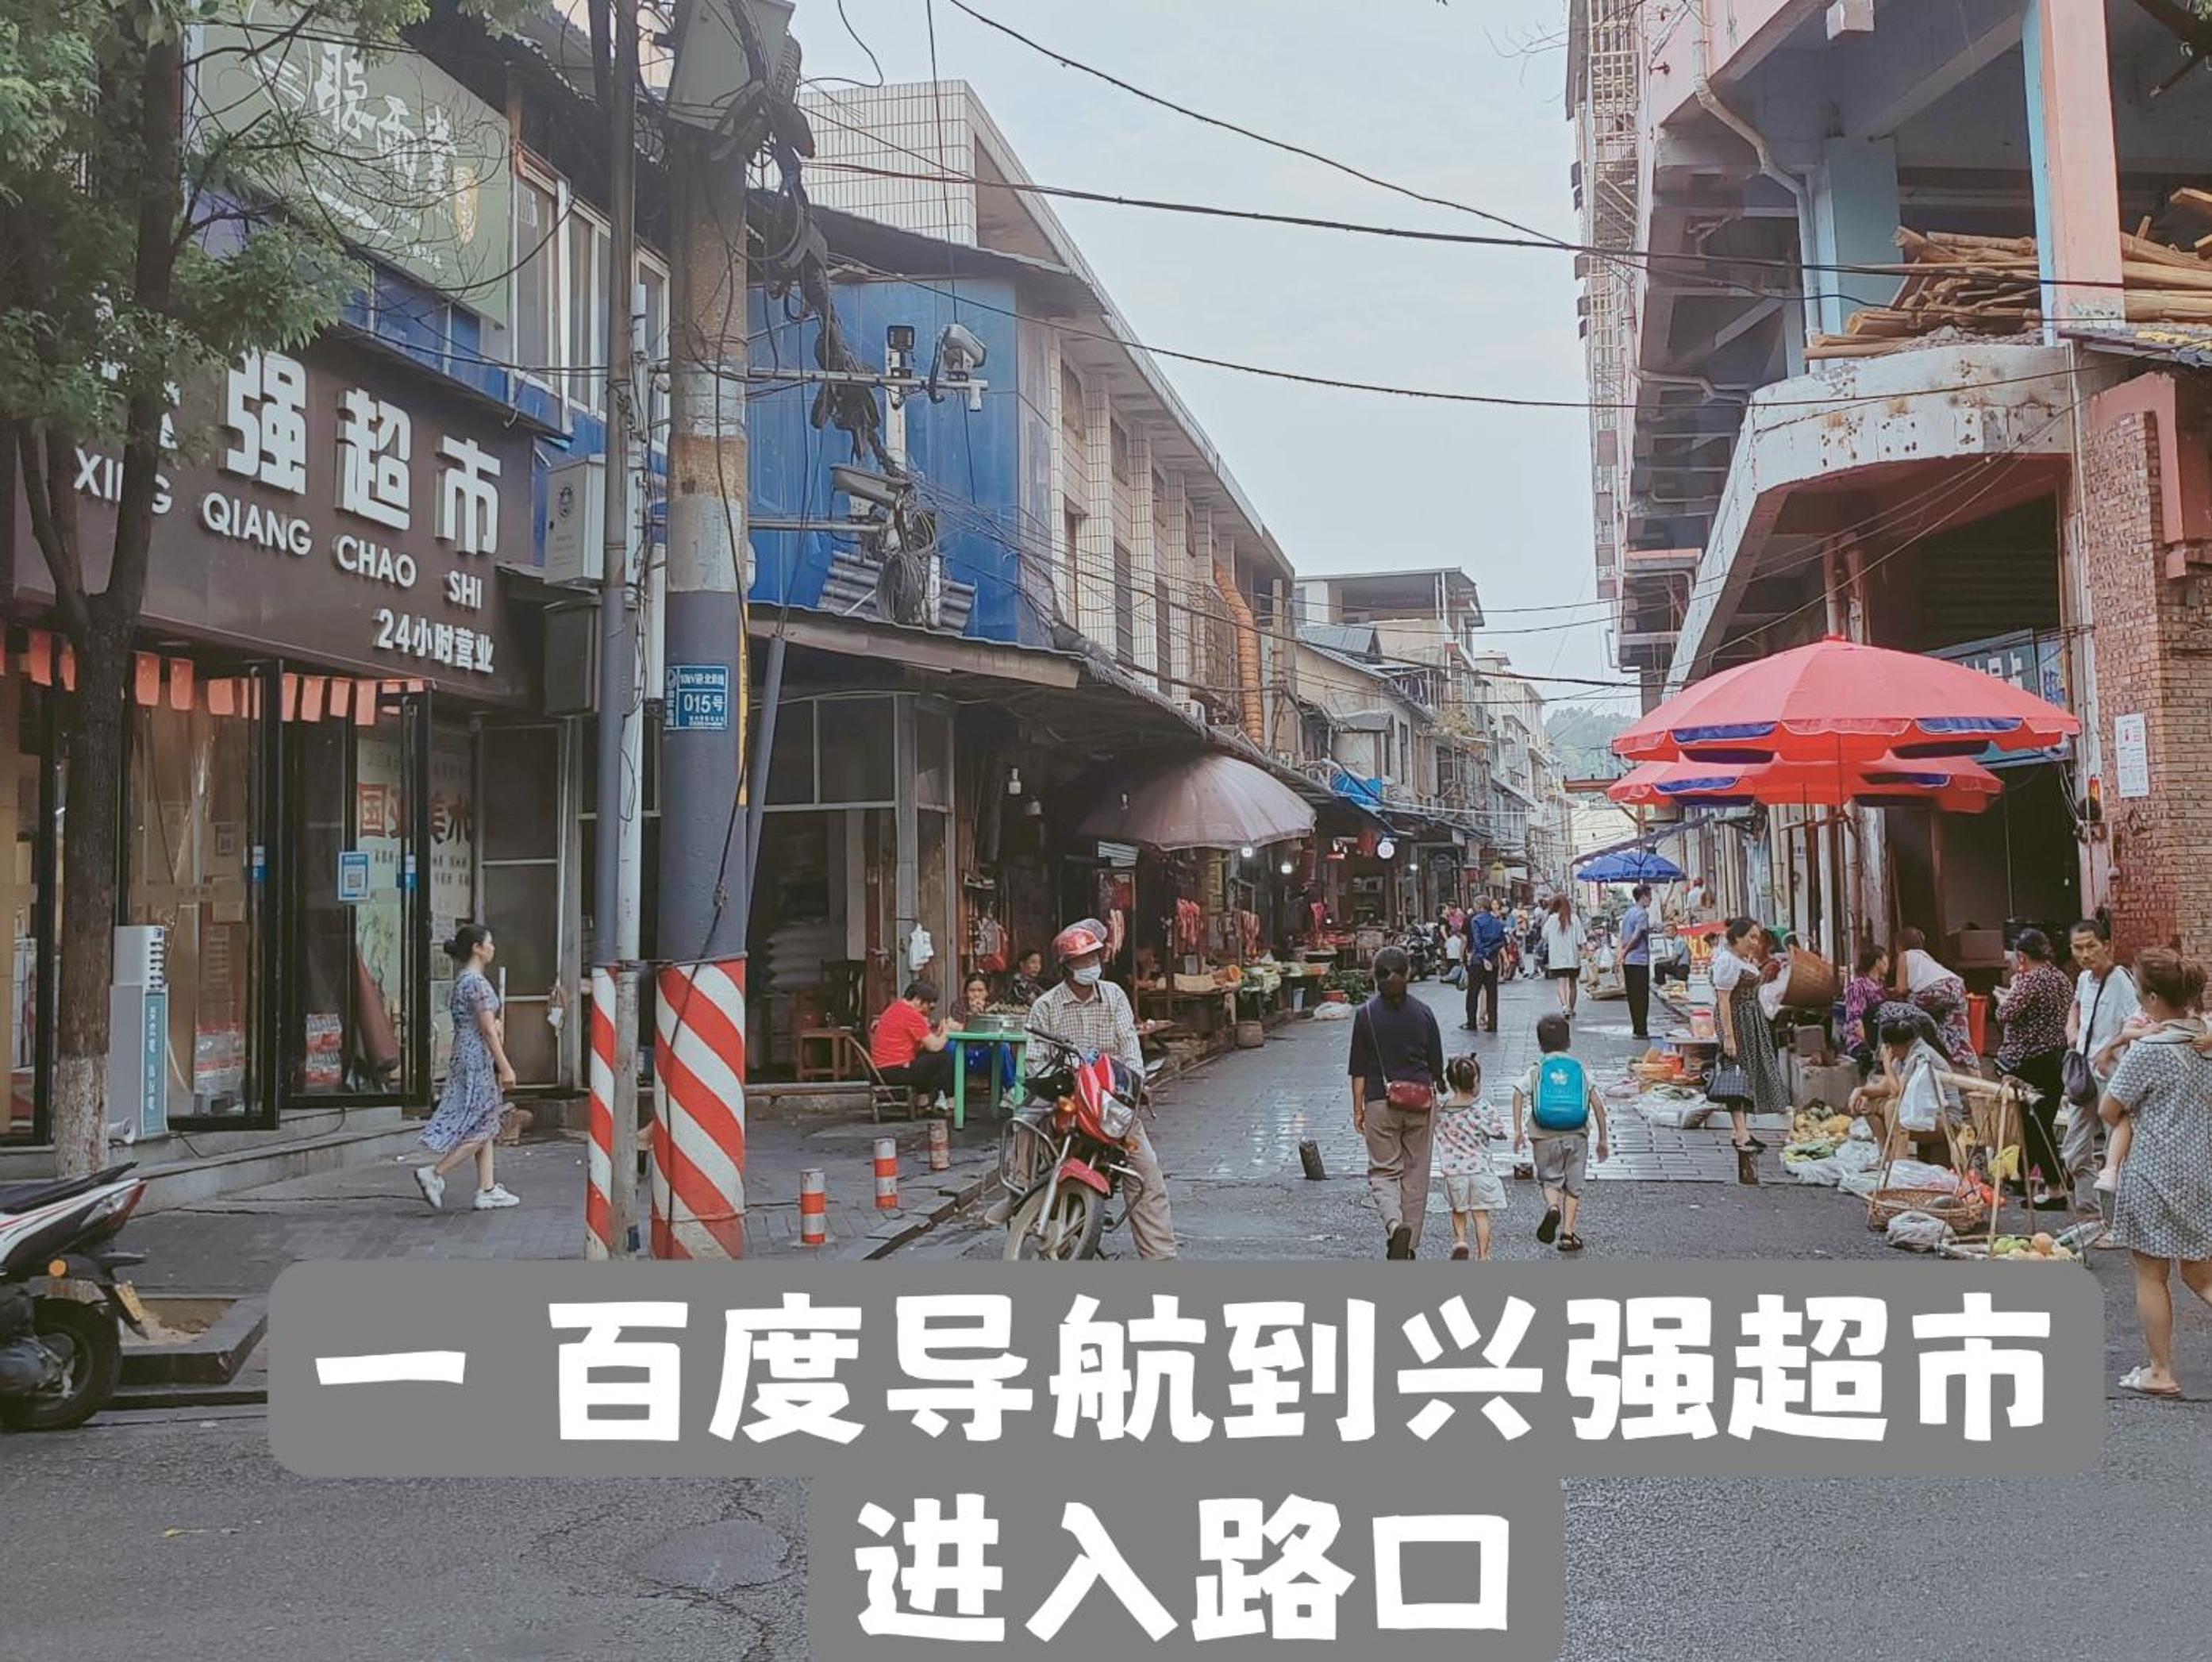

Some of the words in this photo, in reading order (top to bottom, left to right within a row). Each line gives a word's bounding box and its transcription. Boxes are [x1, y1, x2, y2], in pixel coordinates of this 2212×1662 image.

[94, 346, 502, 555] 强超市
[203, 492, 312, 556] QIANG
[337, 535, 417, 588] CHAO
[448, 570, 482, 610] SHI
[376, 609, 494, 674] 24小时营业
[683, 694, 724, 714] 015号
